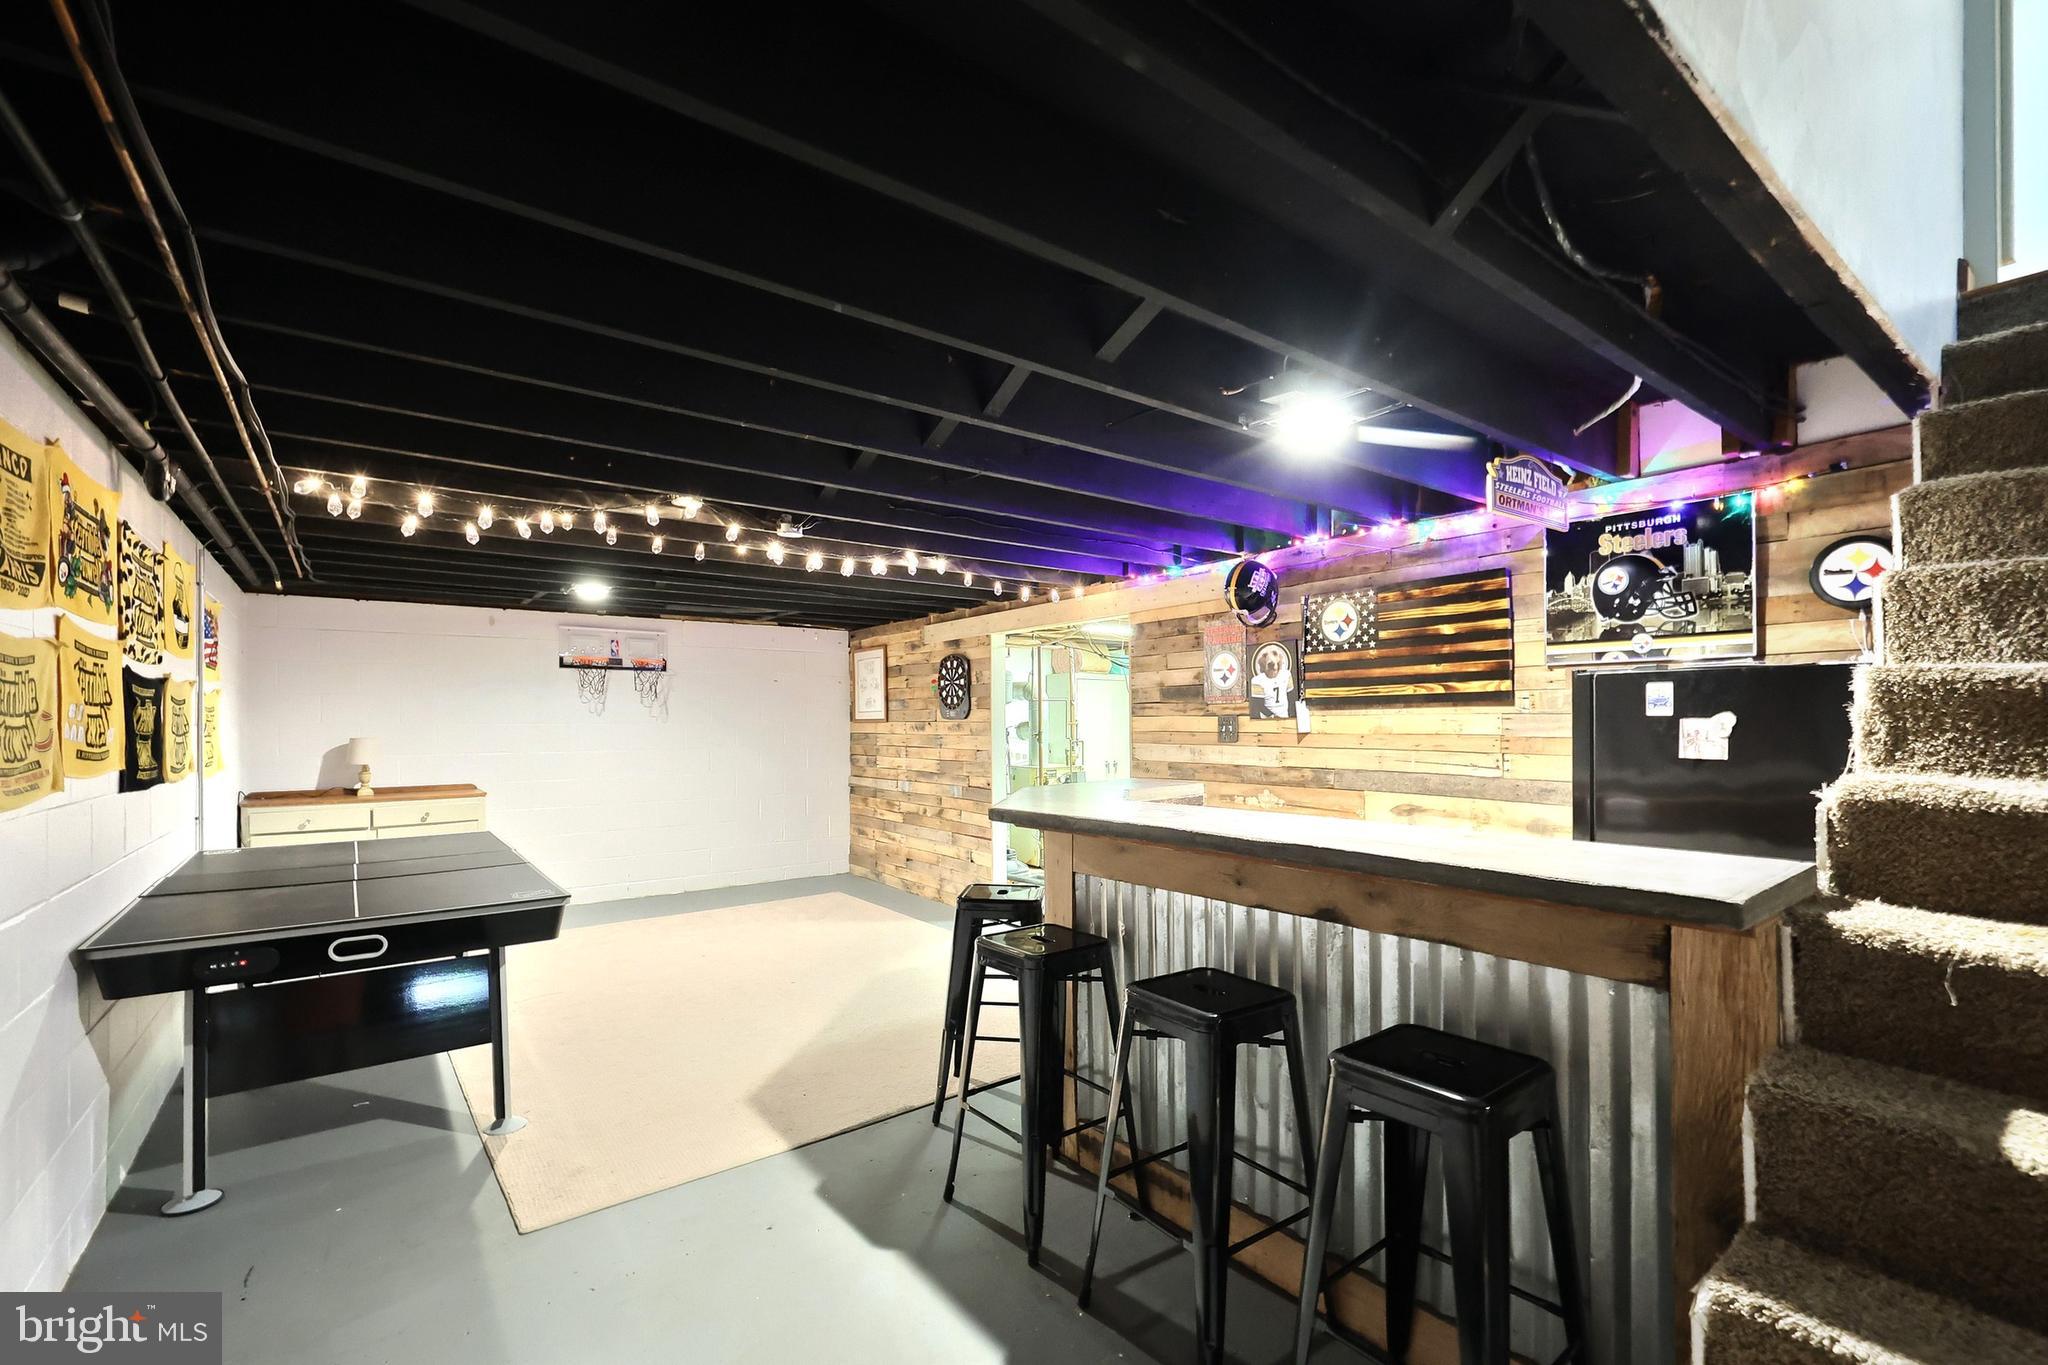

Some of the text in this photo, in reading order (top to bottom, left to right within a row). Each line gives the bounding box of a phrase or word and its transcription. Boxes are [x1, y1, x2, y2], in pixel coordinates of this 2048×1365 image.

[0, 446, 28, 479] NCO
[1494, 481, 1531, 499] STEELERS
[1505, 465, 1557, 497] HEINZ FIELD
[1604, 513, 1681, 533] PITTSBURGH
[1598, 527, 1688, 556] Steelers
[1272, 686, 1280, 704] 7
